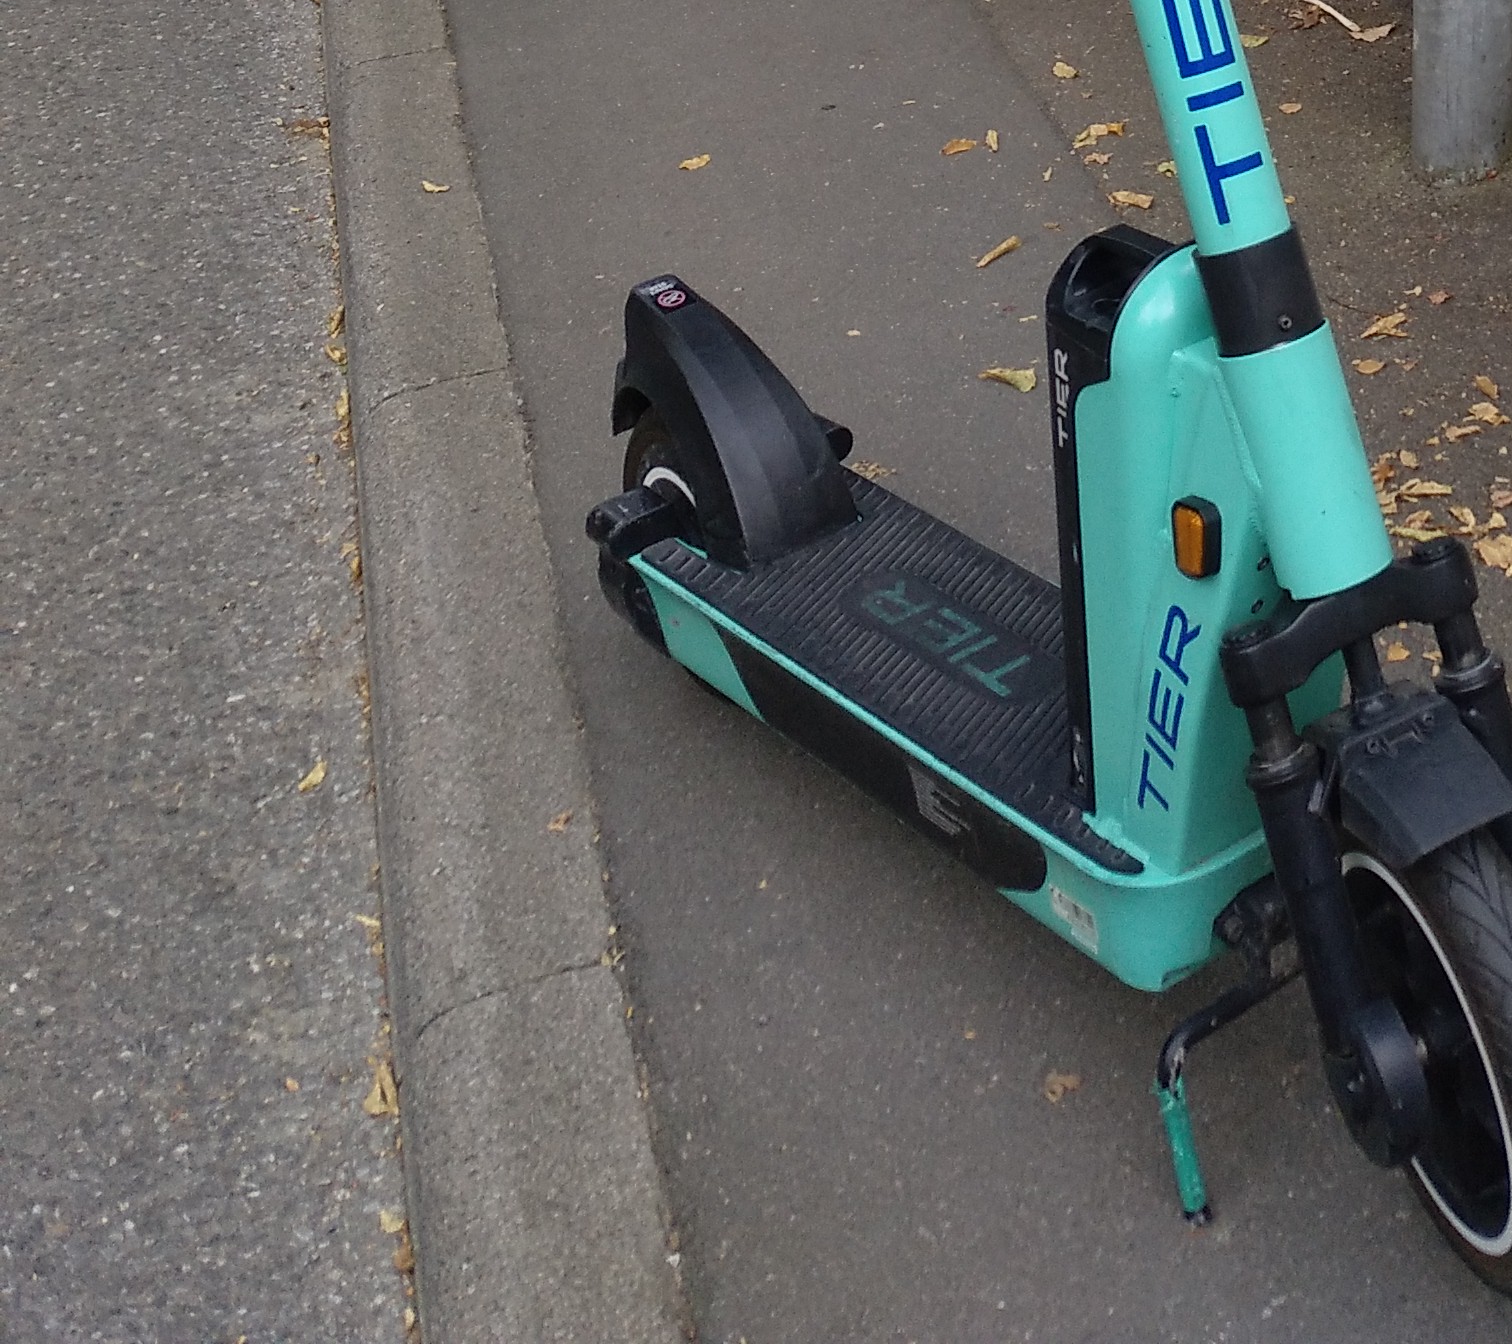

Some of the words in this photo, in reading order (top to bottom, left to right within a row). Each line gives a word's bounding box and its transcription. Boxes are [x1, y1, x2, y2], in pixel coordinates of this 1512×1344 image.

[1056, 347, 1072, 450] TIER
[860, 579, 1032, 698] TIER
[1136, 603, 1203, 813] TIER
